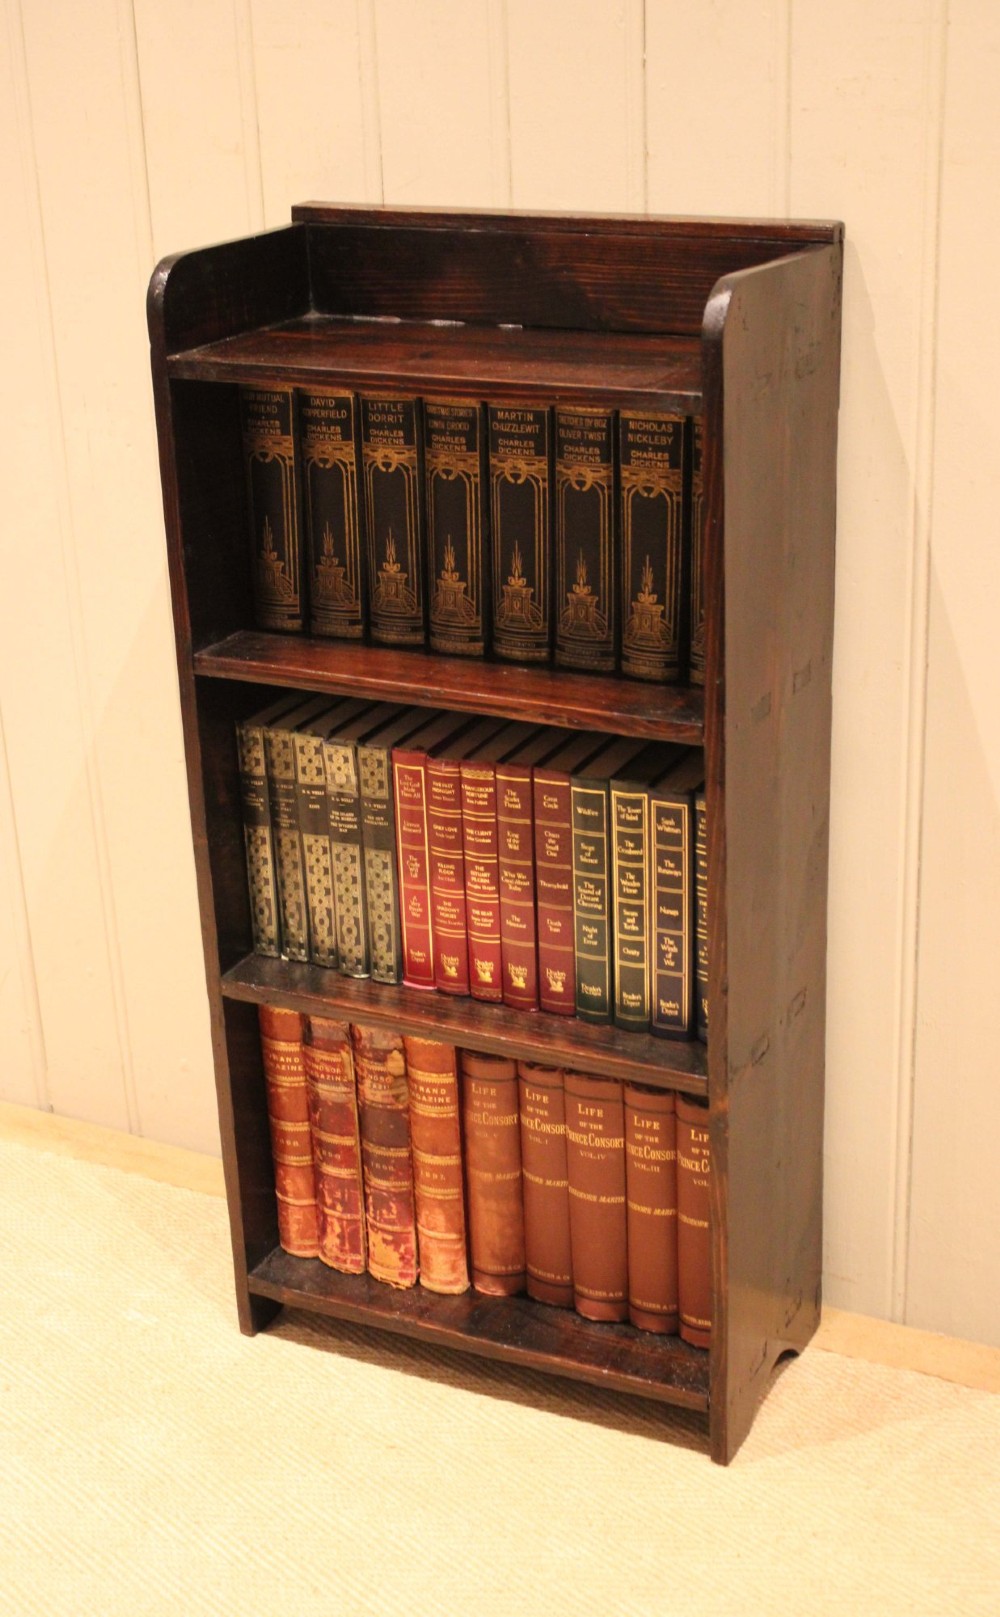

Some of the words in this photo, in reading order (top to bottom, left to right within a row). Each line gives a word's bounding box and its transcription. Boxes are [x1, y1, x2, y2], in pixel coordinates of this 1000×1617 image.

[310, 398, 335, 407] DAVID
[368, 402, 404, 412] LITTLE
[368, 413, 404, 423] DORRIT
[498, 411, 533, 422] MARTIN
[307, 424, 341, 433] CHARLES
[492, 422, 540, 434] CHUZZLEWIT
[629, 421, 673, 432] NICHOLAS
[306, 432, 342, 440] DICKENS
[370, 429, 404, 437] CHARLES
[559, 428, 581, 439] OLIVER
[584, 431, 606, 441] TWIST
[370, 437, 404, 445] DICKENS
[432, 434, 466, 444] CHARLES
[498, 438, 534, 448] CHARLES
[628, 434, 674, 445] NICKLEBY
[432, 442, 467, 452] DICKENS
[498, 447, 535, 456] DICKENS
[564, 445, 600, 454] CHARLES
[564, 453, 600, 462] DICKENS
[631, 450, 669, 460] CHARLES
[631, 459, 670, 468] DICKENS
[413, 1082, 446, 1095] TRAND
[535, 1118, 566, 1135] CONSOR
[589, 1123, 603, 1131] THE
[644, 1135, 659, 1143] THE
[690, 1129, 709, 1143] LIF
[643, 1146, 676, 1160] CONSOR
